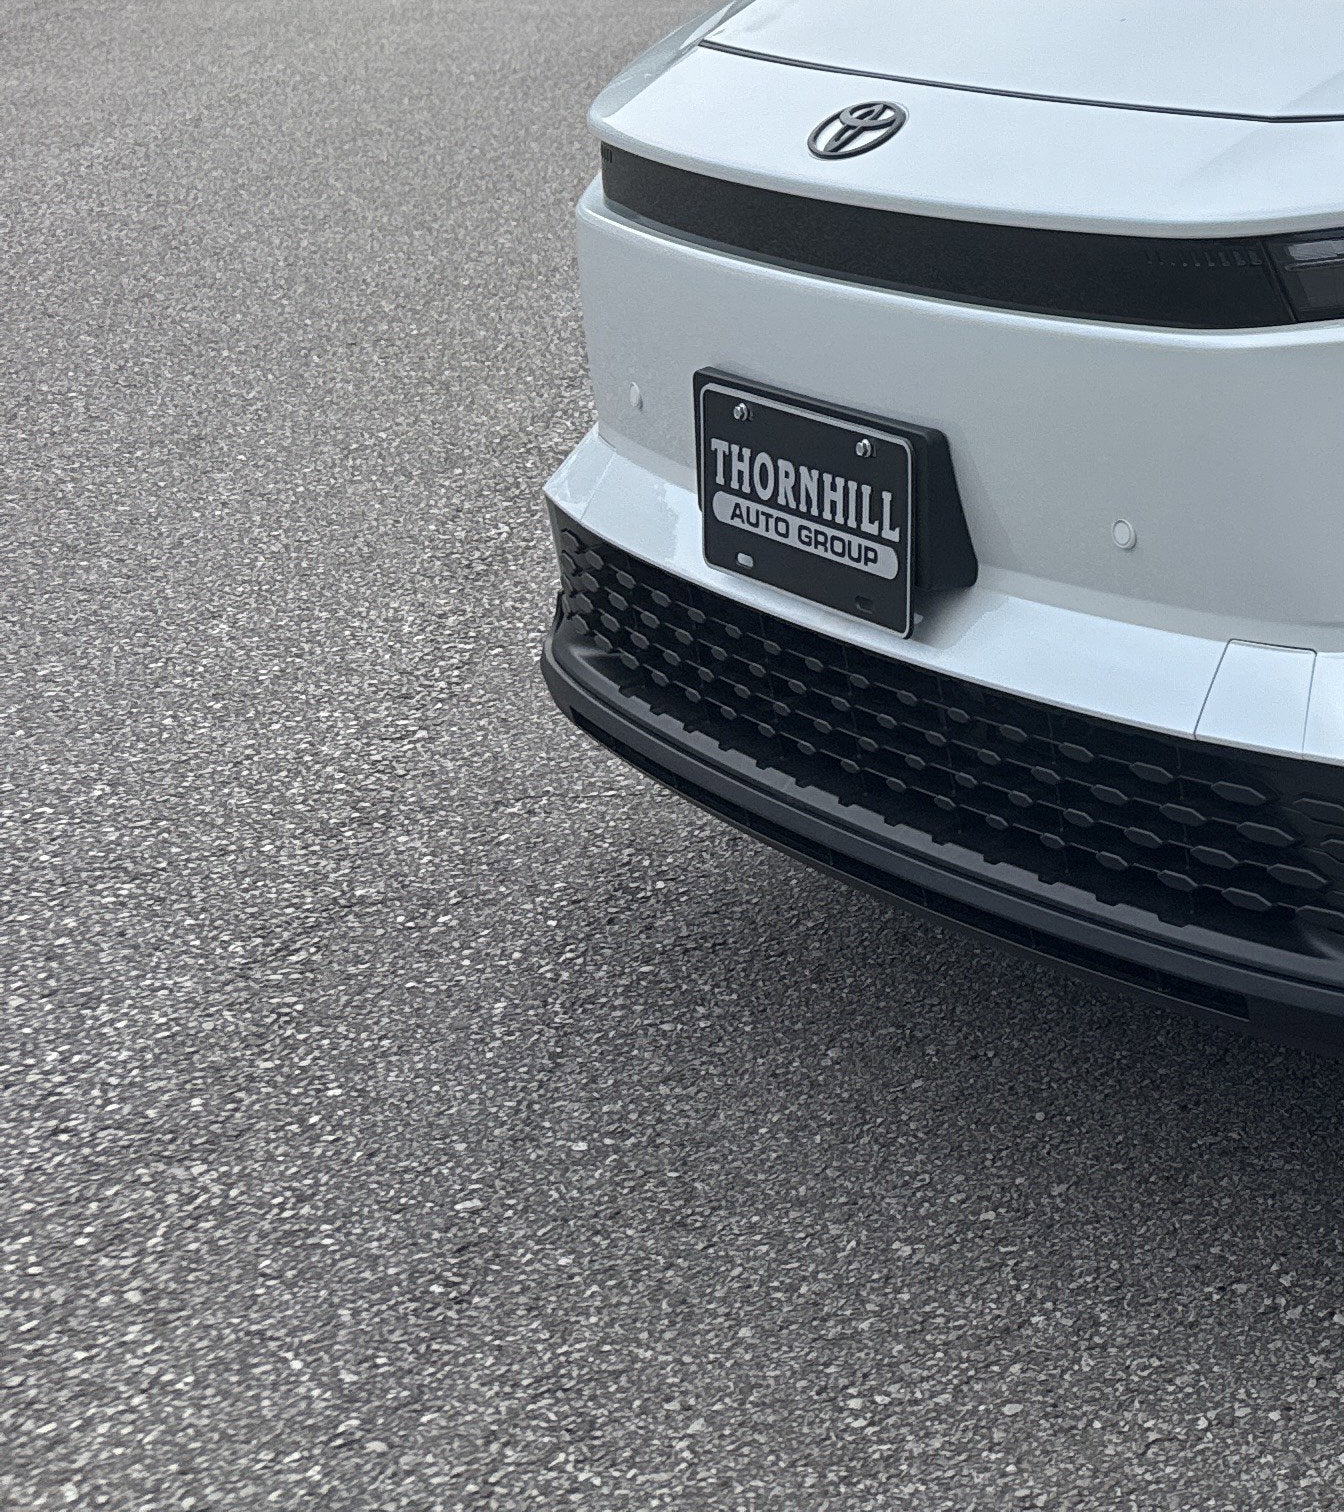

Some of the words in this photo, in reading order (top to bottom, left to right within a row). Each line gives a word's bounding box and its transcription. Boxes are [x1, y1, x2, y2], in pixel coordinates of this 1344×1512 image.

[710, 438, 900, 543] THORNHILL
[730, 502, 790, 538] AUTO
[797, 524, 879, 567] GROUP
